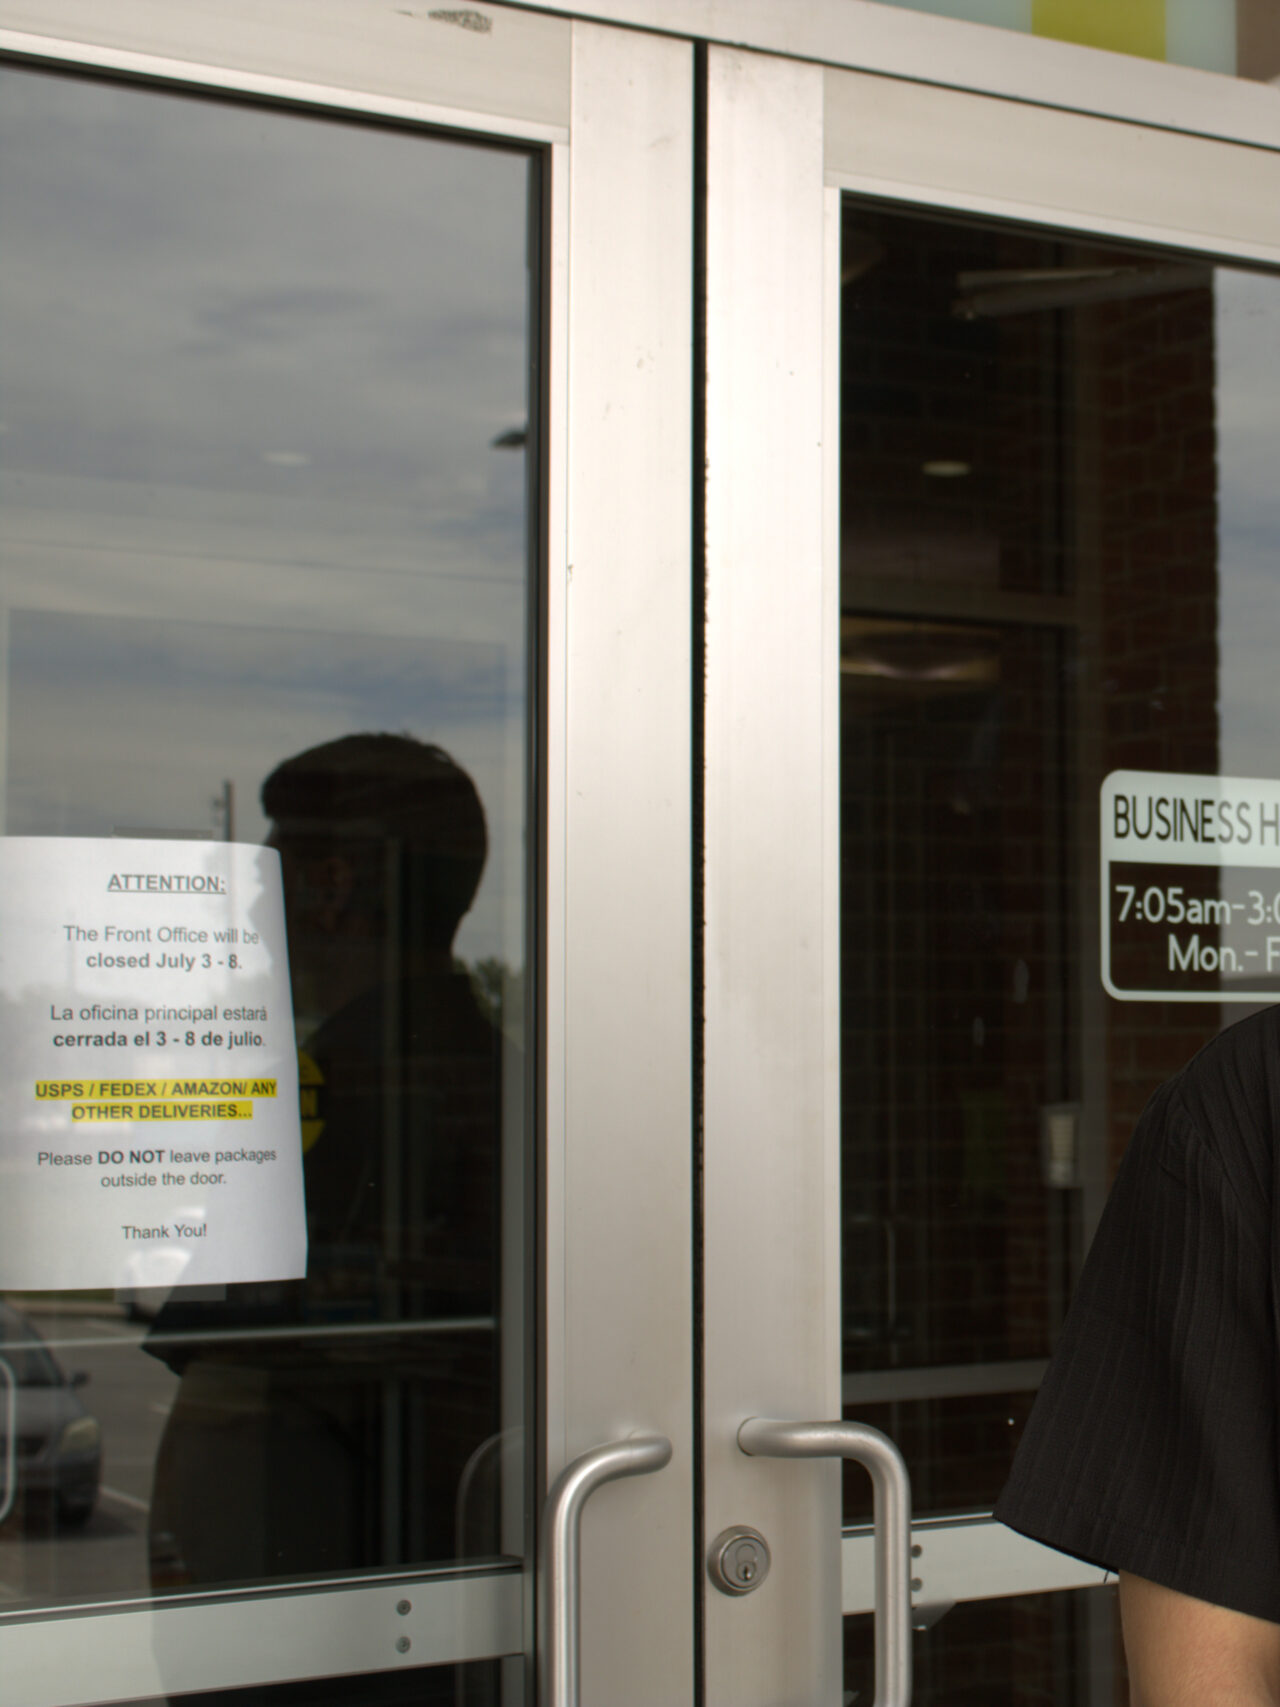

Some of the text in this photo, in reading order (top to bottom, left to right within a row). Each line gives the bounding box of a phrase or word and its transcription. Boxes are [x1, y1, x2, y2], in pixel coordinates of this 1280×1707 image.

[1113, 794, 1252, 845] BUSINESS
[107, 873, 227, 896] ATTENTION:
[62, 924, 259, 945] The Front Office will be
[85, 951, 151, 969] closed
[155, 952, 196, 973] July
[201, 952, 213, 970] 3
[227, 952, 243, 971] 8.
[50, 1003, 268, 1025] La oficina principal estará
[52, 1030, 128, 1048] cerrada
[132, 1030, 151, 1047] el
[155, 1030, 168, 1047] 3
[184, 1030, 196, 1047] 8
[200, 1030, 224, 1047] de
[35, 1082, 85, 1099] USPS
[99, 1082, 157, 1097] FEDEX
[250, 1081, 277, 1095] ANY
[71, 1103, 252, 1121] OTHER DELIVERIES...
[37, 1148, 278, 1167] Please DO NOT leave packages
[100, 1170, 227, 1188] outside the door.
[121, 1222, 208, 1240] Thank You!
